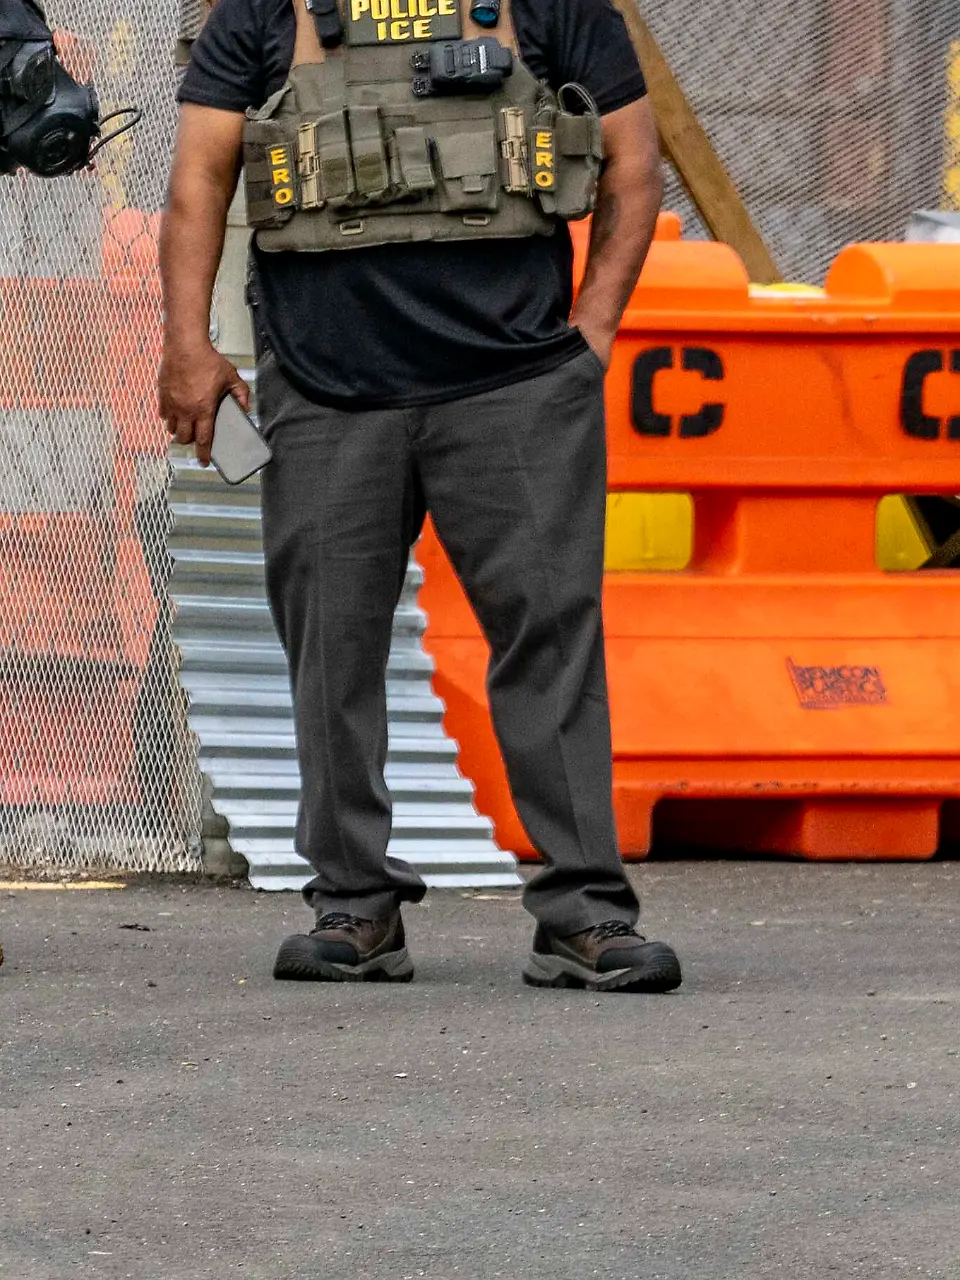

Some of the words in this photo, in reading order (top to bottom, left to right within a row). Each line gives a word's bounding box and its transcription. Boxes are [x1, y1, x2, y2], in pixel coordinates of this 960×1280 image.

[376, 18, 434, 41] ICE
[270, 147, 294, 205] ERO
[534, 131, 554, 188] ERO
[629, 346, 725, 438] C
